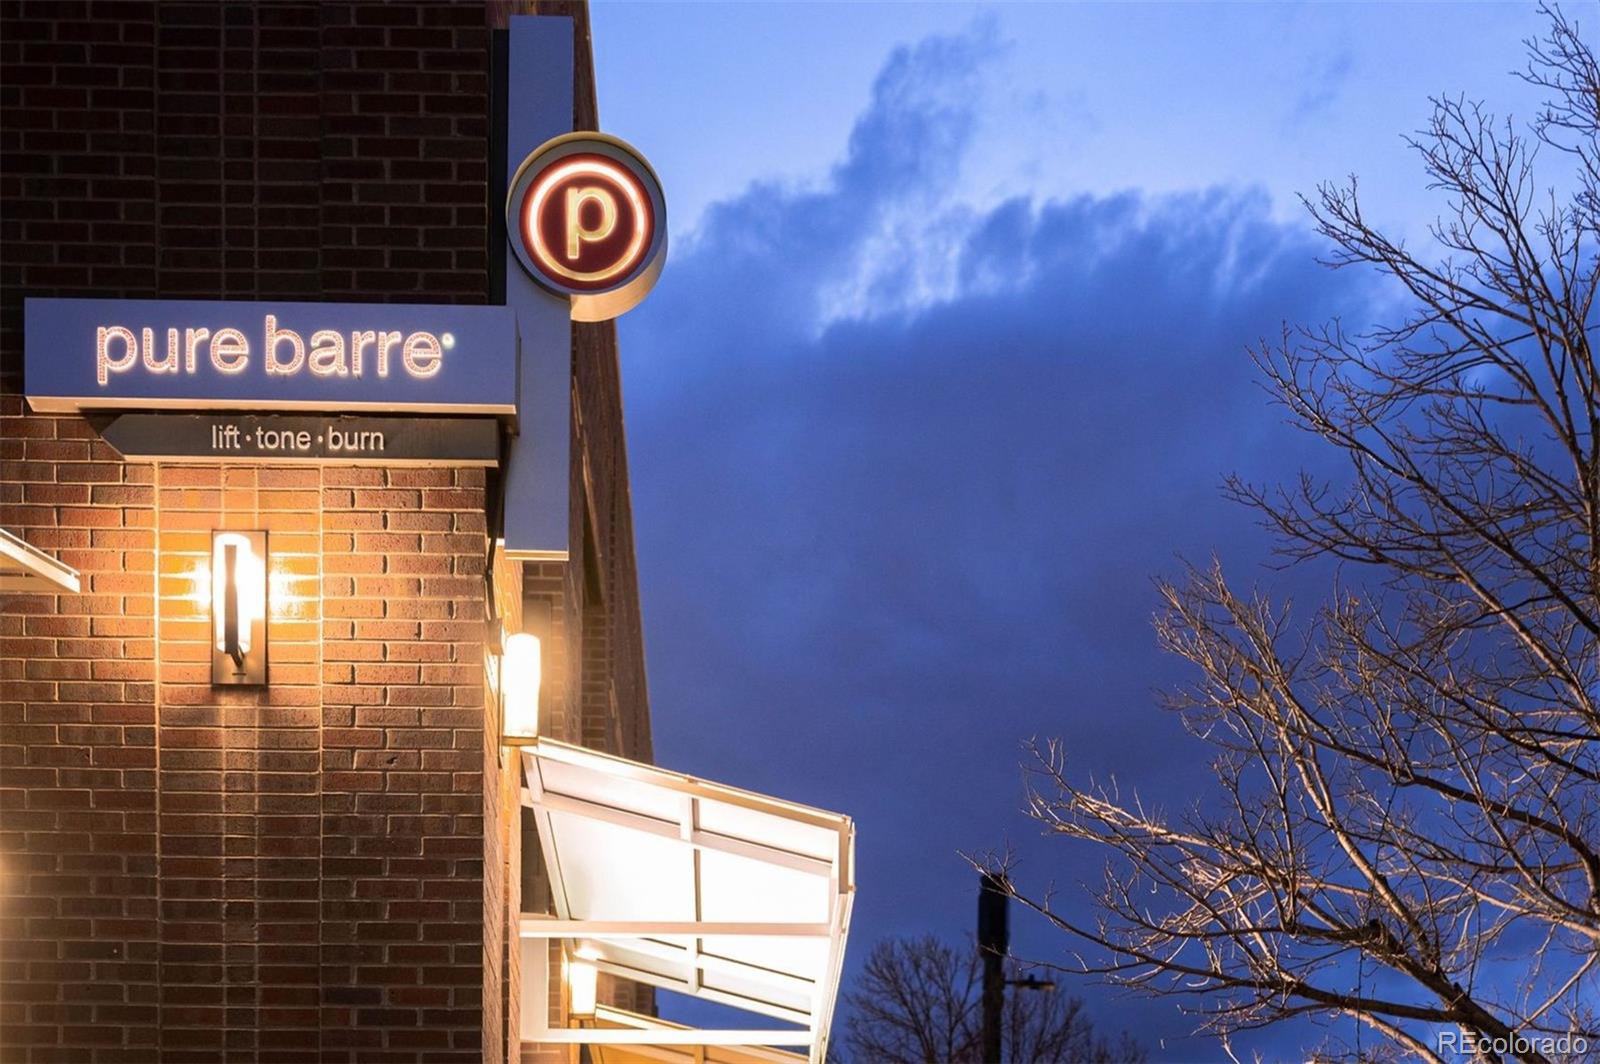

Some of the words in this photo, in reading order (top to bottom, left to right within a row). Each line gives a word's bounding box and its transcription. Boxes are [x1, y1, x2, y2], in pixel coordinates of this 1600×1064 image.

[566, 186, 618, 260] p
[96, 326, 249, 384] pure
[265, 314, 443, 377] barre
